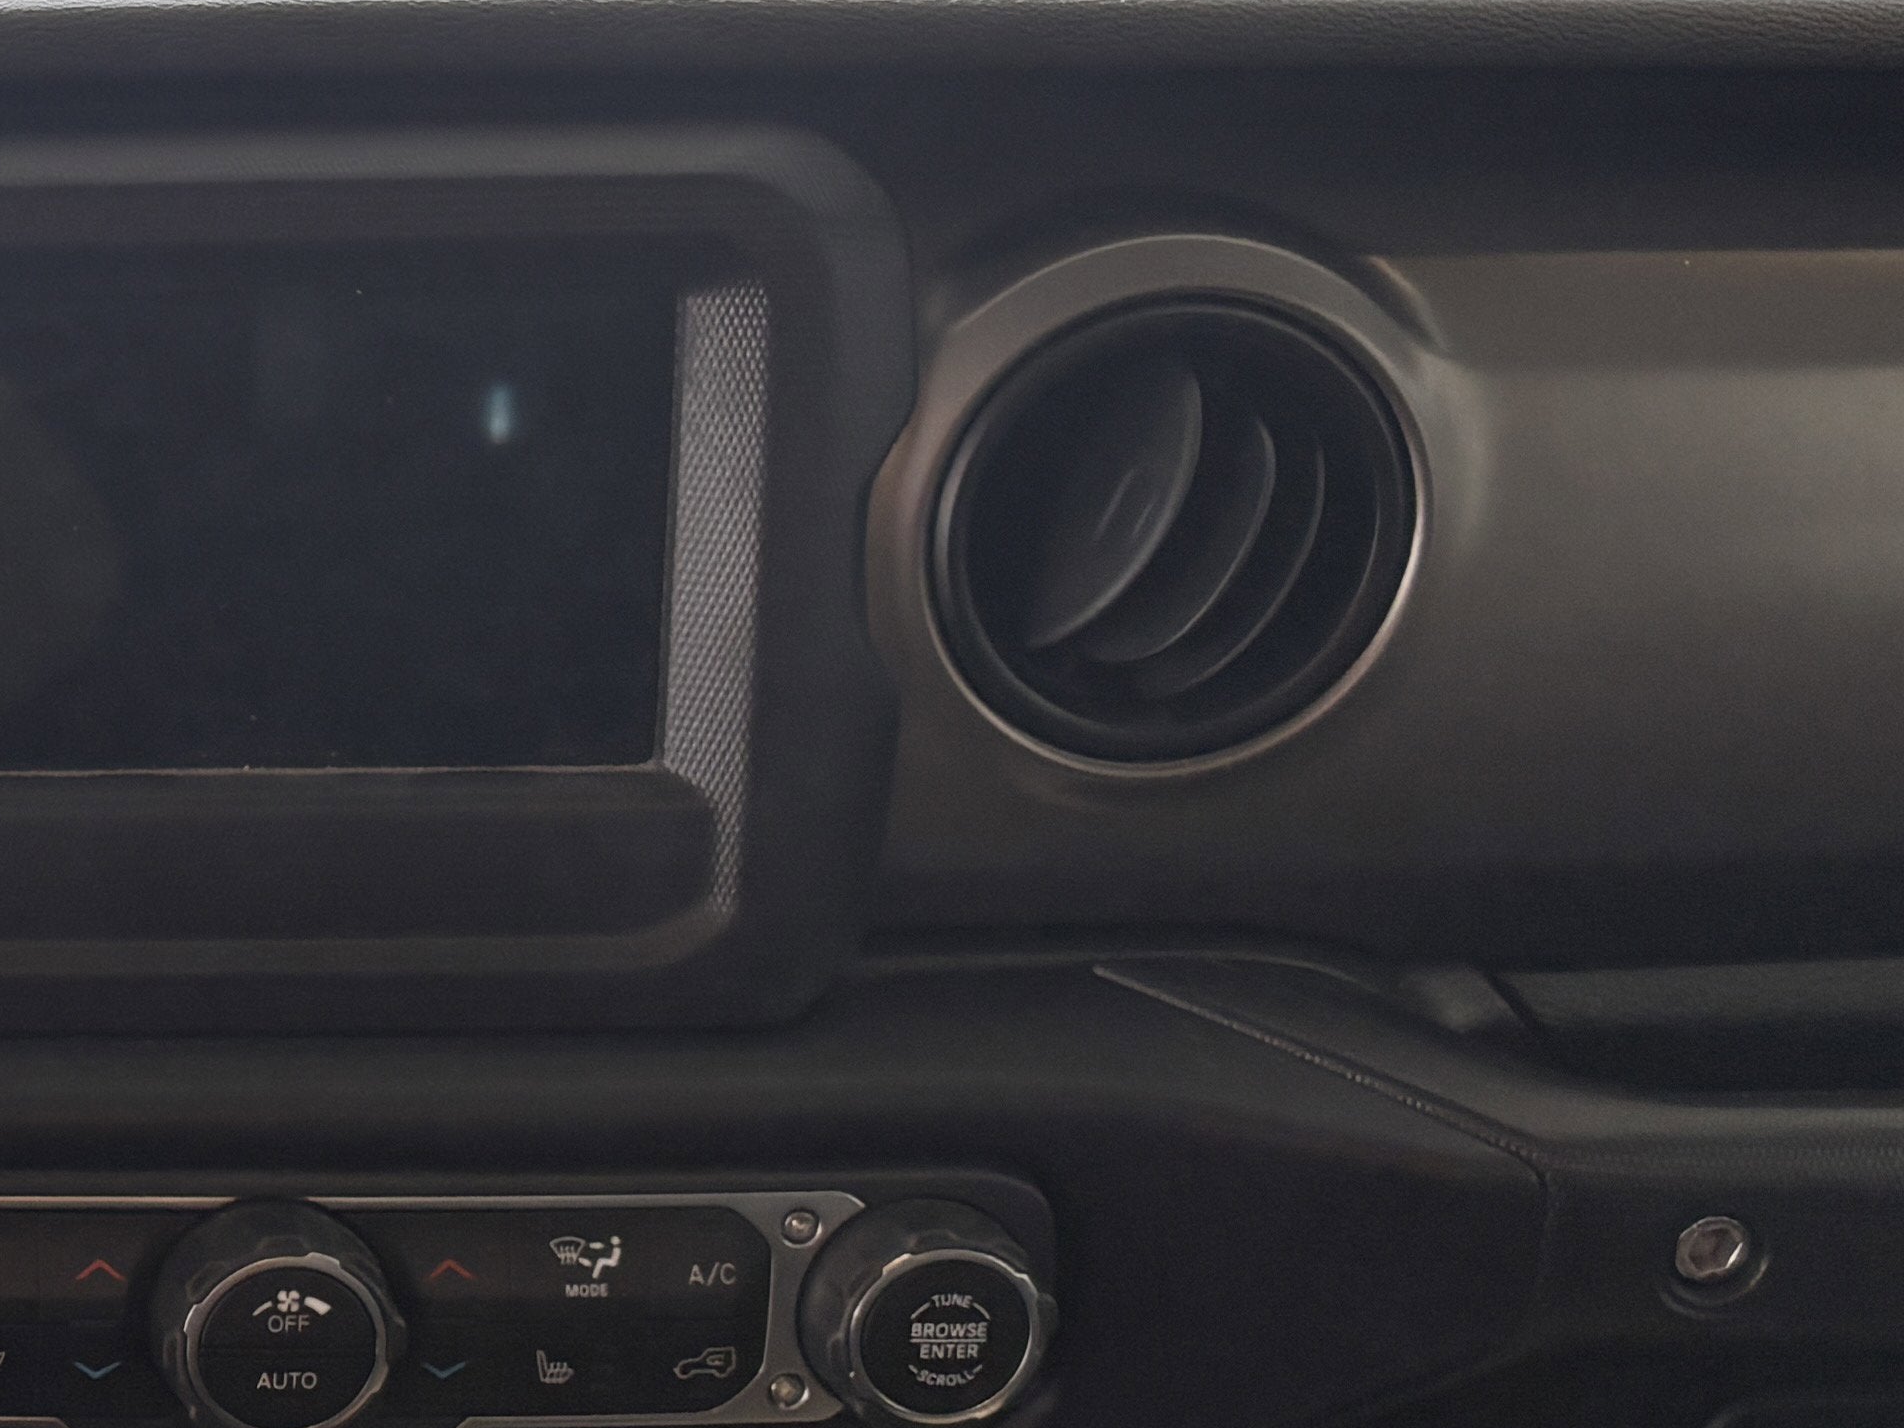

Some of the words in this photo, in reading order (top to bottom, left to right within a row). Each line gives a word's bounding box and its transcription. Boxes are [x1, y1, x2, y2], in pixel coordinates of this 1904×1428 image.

[688, 1262, 738, 1287] A/C
[565, 1282, 609, 1298] MODE
[930, 1293, 974, 1311] TUNE
[266, 1313, 310, 1334] OFF
[910, 1321, 988, 1340] BROWSE
[918, 1342, 980, 1362] ENTER
[256, 1370, 318, 1391] AUTO
[914, 1368, 977, 1388] SCROLL
